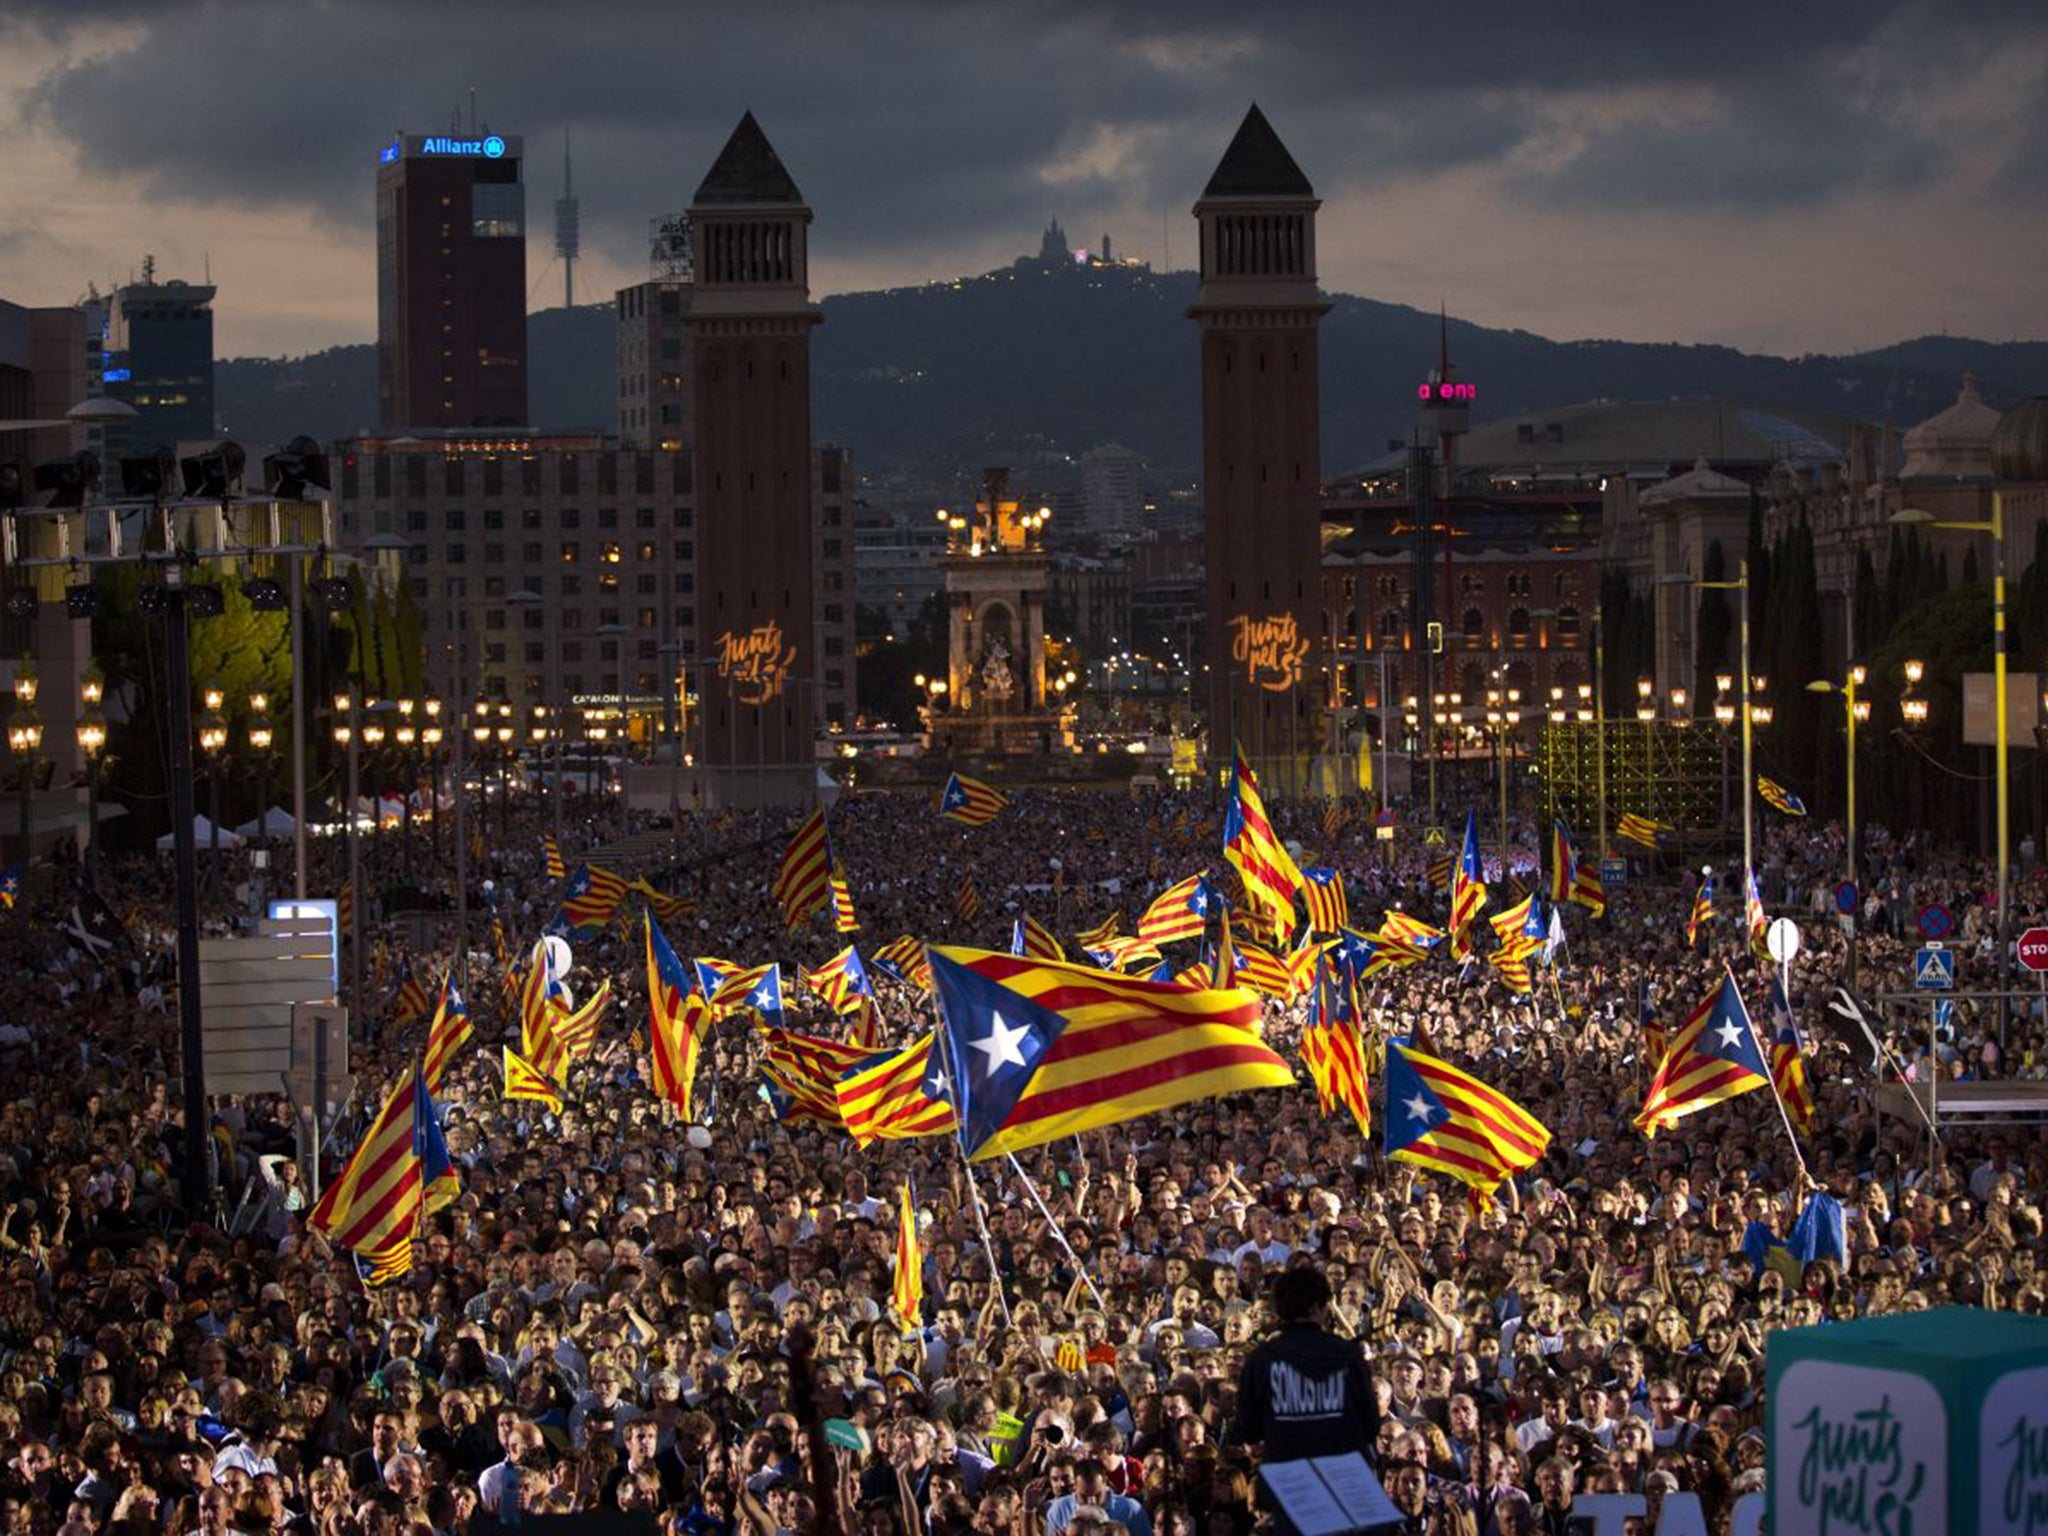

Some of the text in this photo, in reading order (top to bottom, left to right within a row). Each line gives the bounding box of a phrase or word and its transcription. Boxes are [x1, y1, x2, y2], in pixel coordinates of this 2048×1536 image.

[423, 137, 482, 155] Allianz
[1418, 383, 1476, 399] aena
[1791, 1394, 1903, 1507] Junts
